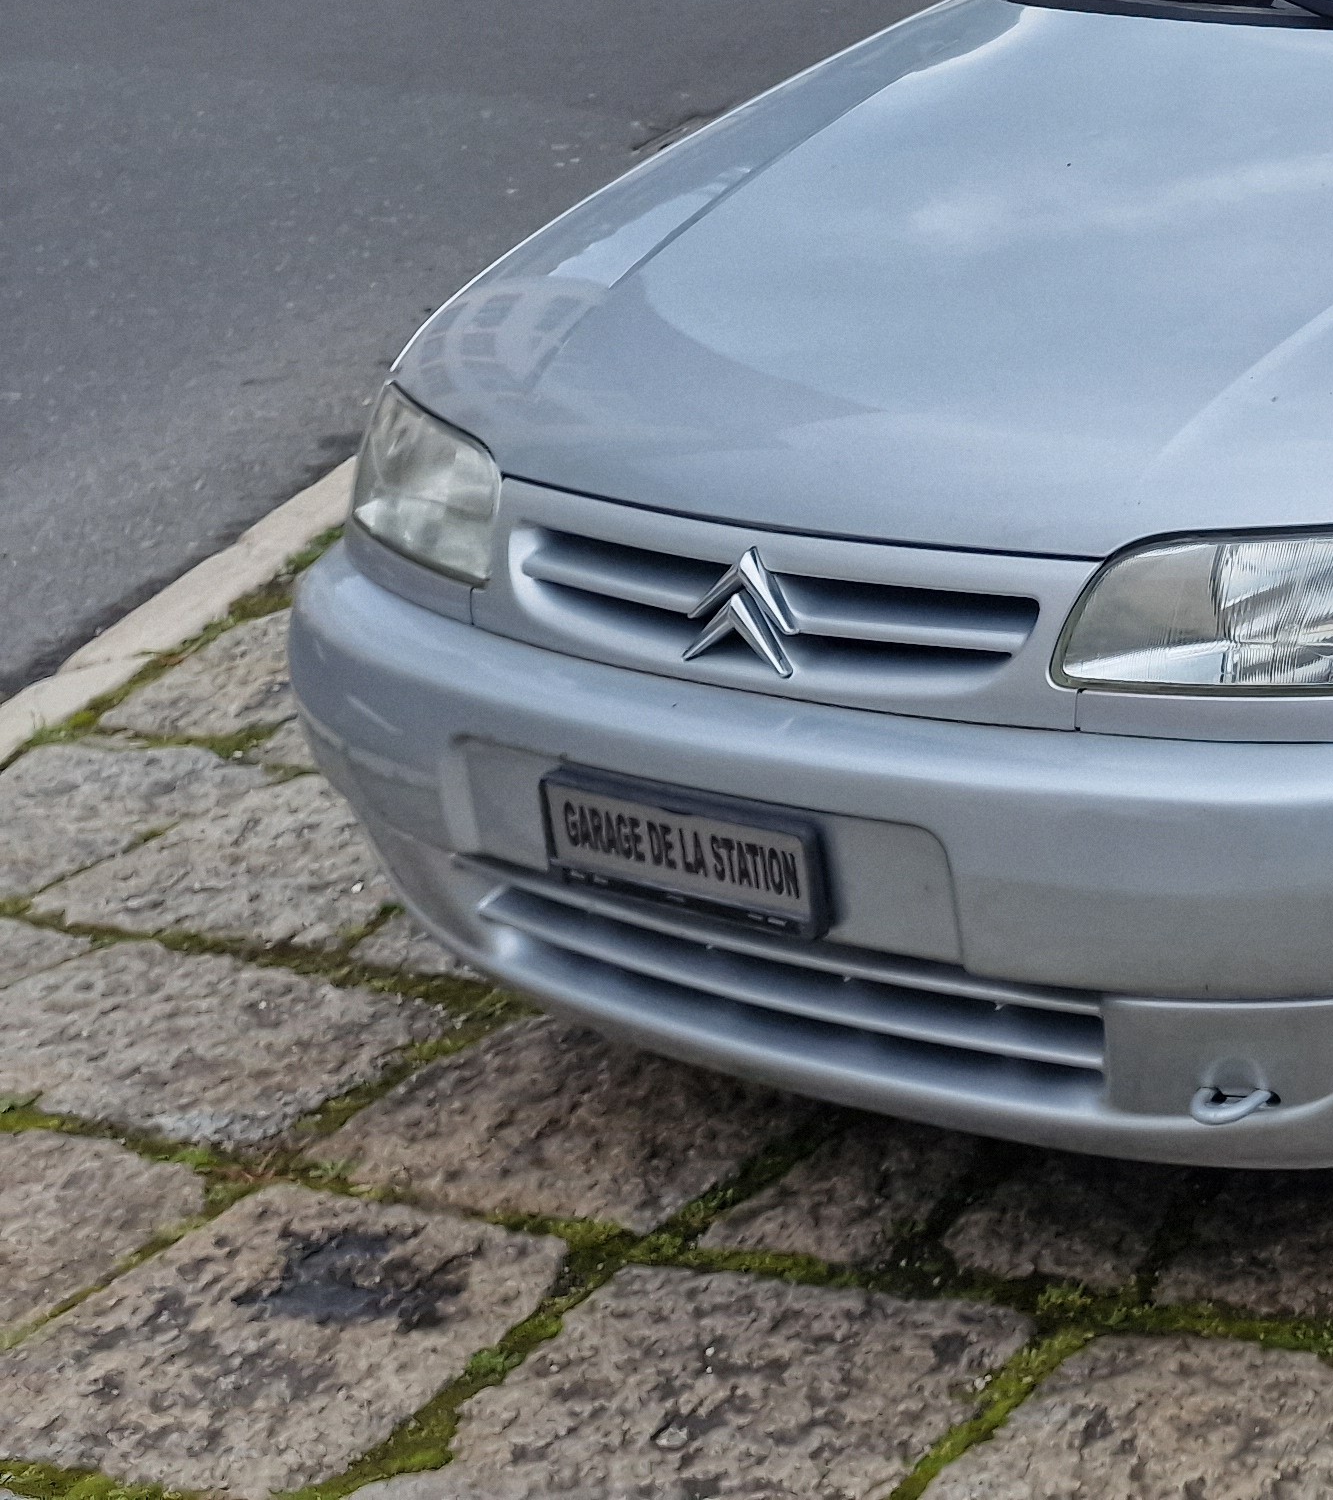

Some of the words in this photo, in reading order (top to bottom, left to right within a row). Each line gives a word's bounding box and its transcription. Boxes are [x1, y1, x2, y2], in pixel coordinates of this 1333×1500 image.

[564, 800, 646, 862] GARAGE
[646, 819, 677, 870] DE
[678, 827, 708, 878] LA
[709, 833, 801, 900] STATION
